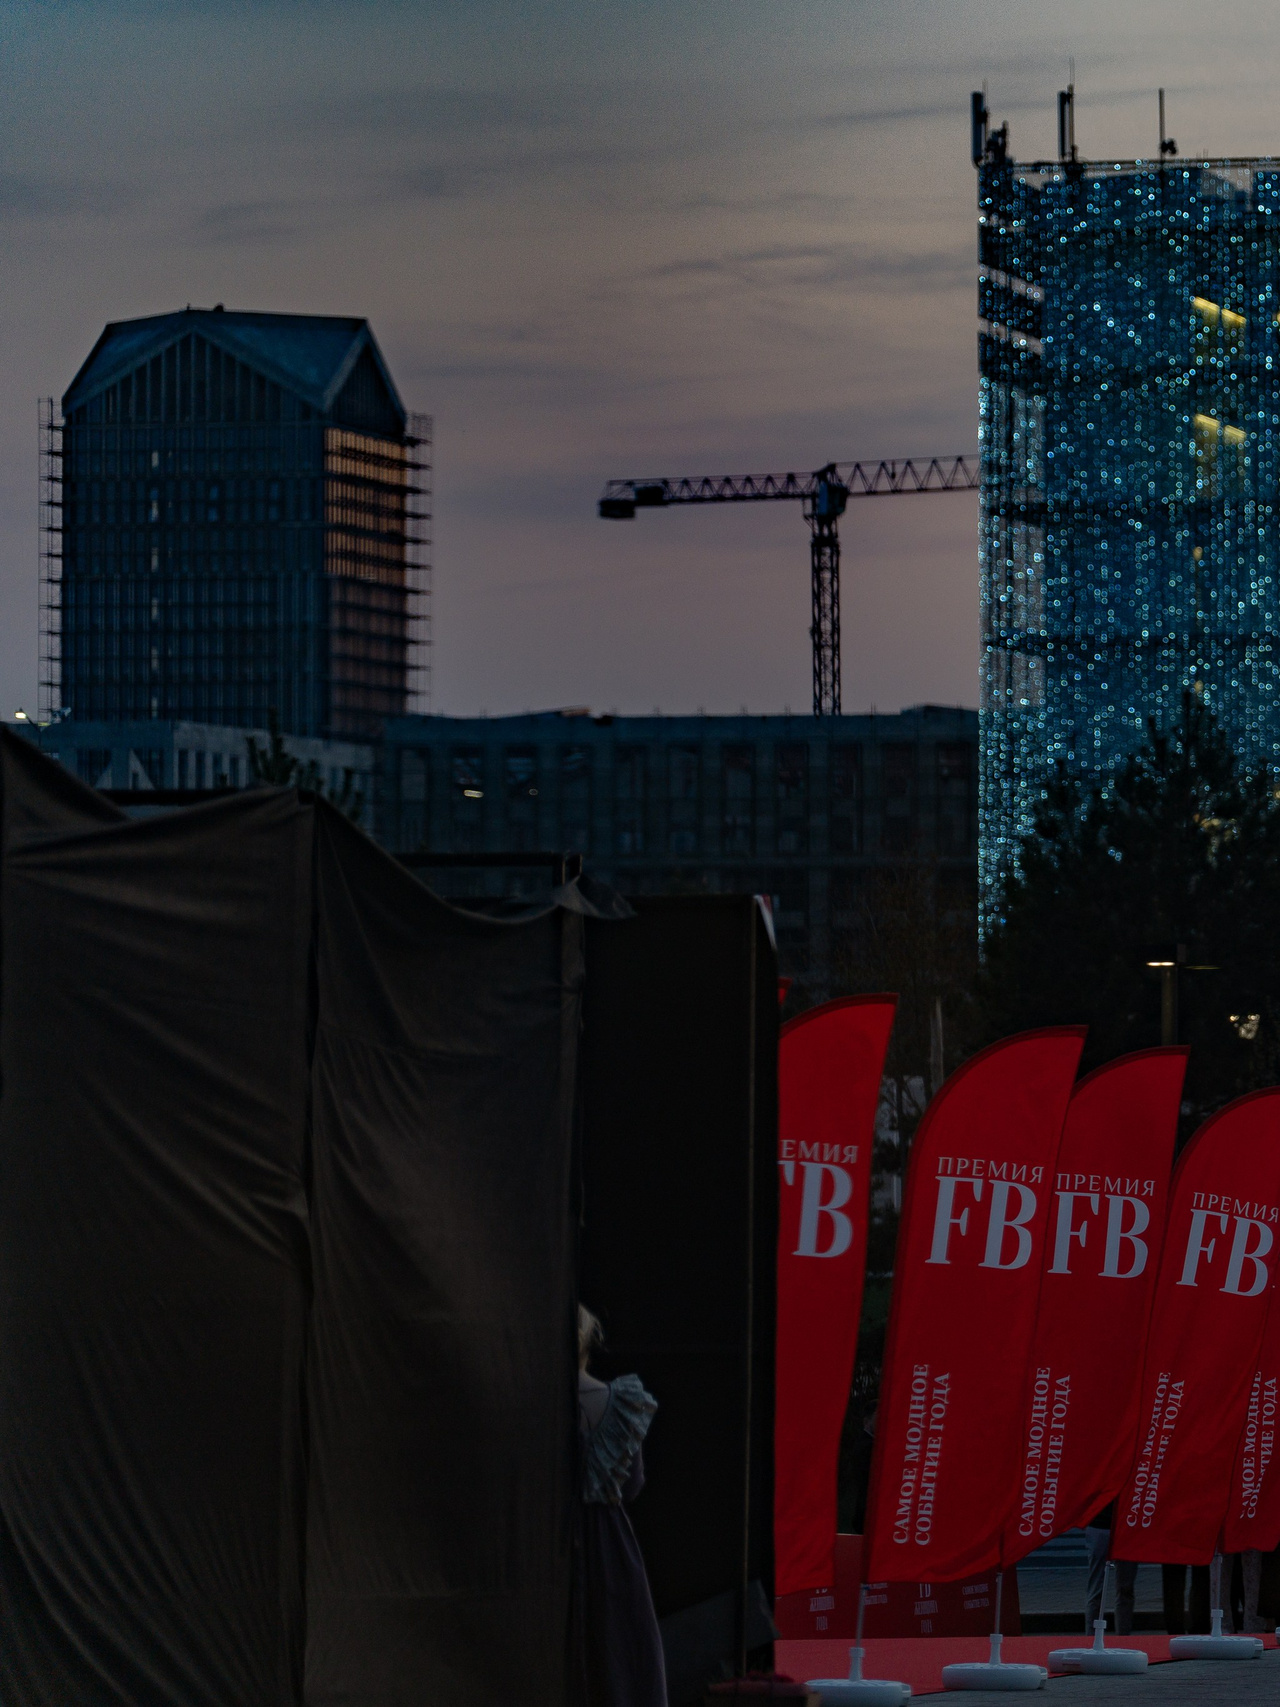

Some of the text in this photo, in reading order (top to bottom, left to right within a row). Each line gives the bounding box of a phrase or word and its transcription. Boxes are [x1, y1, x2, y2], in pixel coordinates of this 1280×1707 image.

[937, 1157, 1045, 1184] ПРЕМИЯ
[1056, 1173, 1156, 1197] ПРЕМИЯ
[1193, 1192, 1279, 1223] ПРЕМИЯ
[925, 1176, 1038, 1271] FB
[1047, 1191, 1150, 1279] FB
[1176, 1208, 1274, 1297] FB
[1163, 1380, 1185, 1431] ГОДА
[1262, 1377, 1278, 1426] ГОДА
[893, 1364, 930, 1544] САМОЕ МОДНОЕ
[914, 1372, 951, 1546] СОБЫТИЕ ГОДА
[1019, 1367, 1050, 1536] САМОЕ МОДНОЕ
[1039, 1375, 1071, 1537] СОБЫТИЕ ГОДА
[1126, 1372, 1171, 1527] САМОЕ МОДНОЕ
